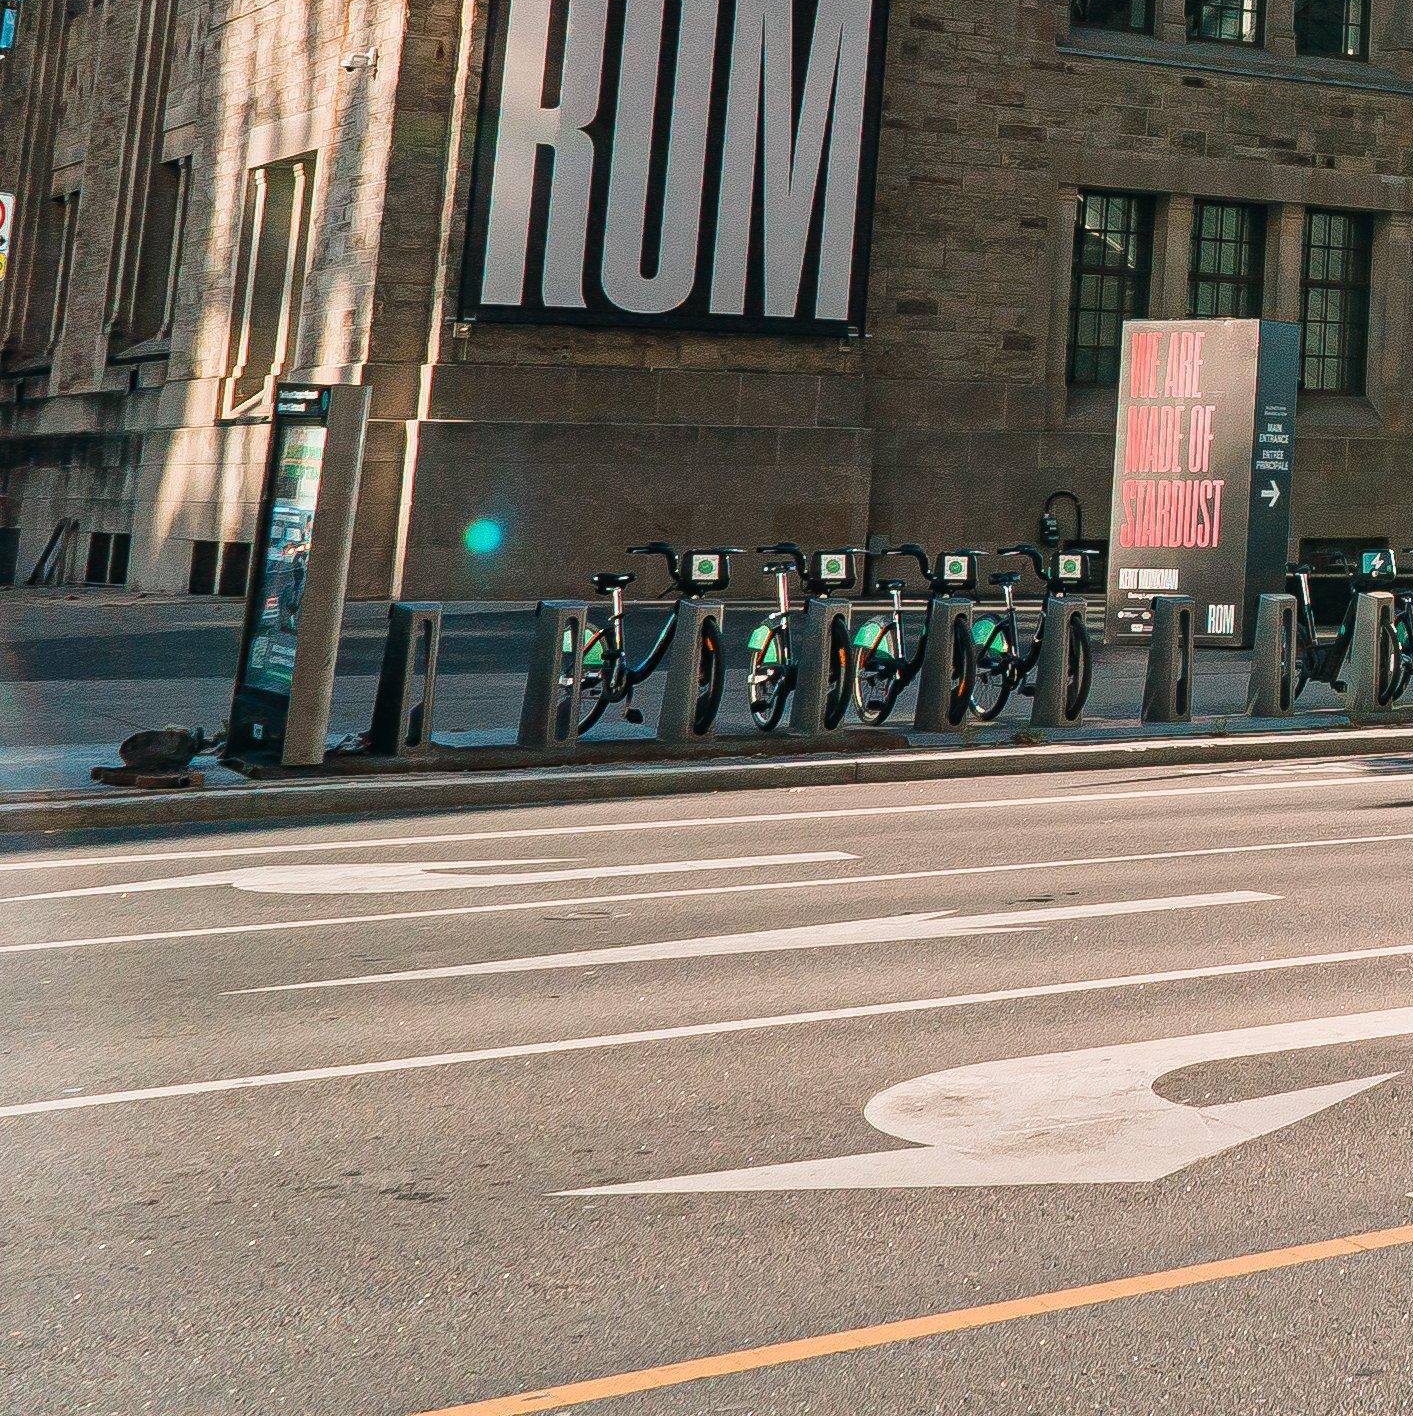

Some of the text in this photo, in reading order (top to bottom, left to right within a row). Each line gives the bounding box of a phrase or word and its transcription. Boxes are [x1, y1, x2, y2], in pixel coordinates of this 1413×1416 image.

[1130, 332, 1206, 399] WE ARE
[1124, 405, 1216, 473] MADE OF
[1119, 479, 1225, 548] STARDUST
[1207, 604, 1236, 634] ROM
